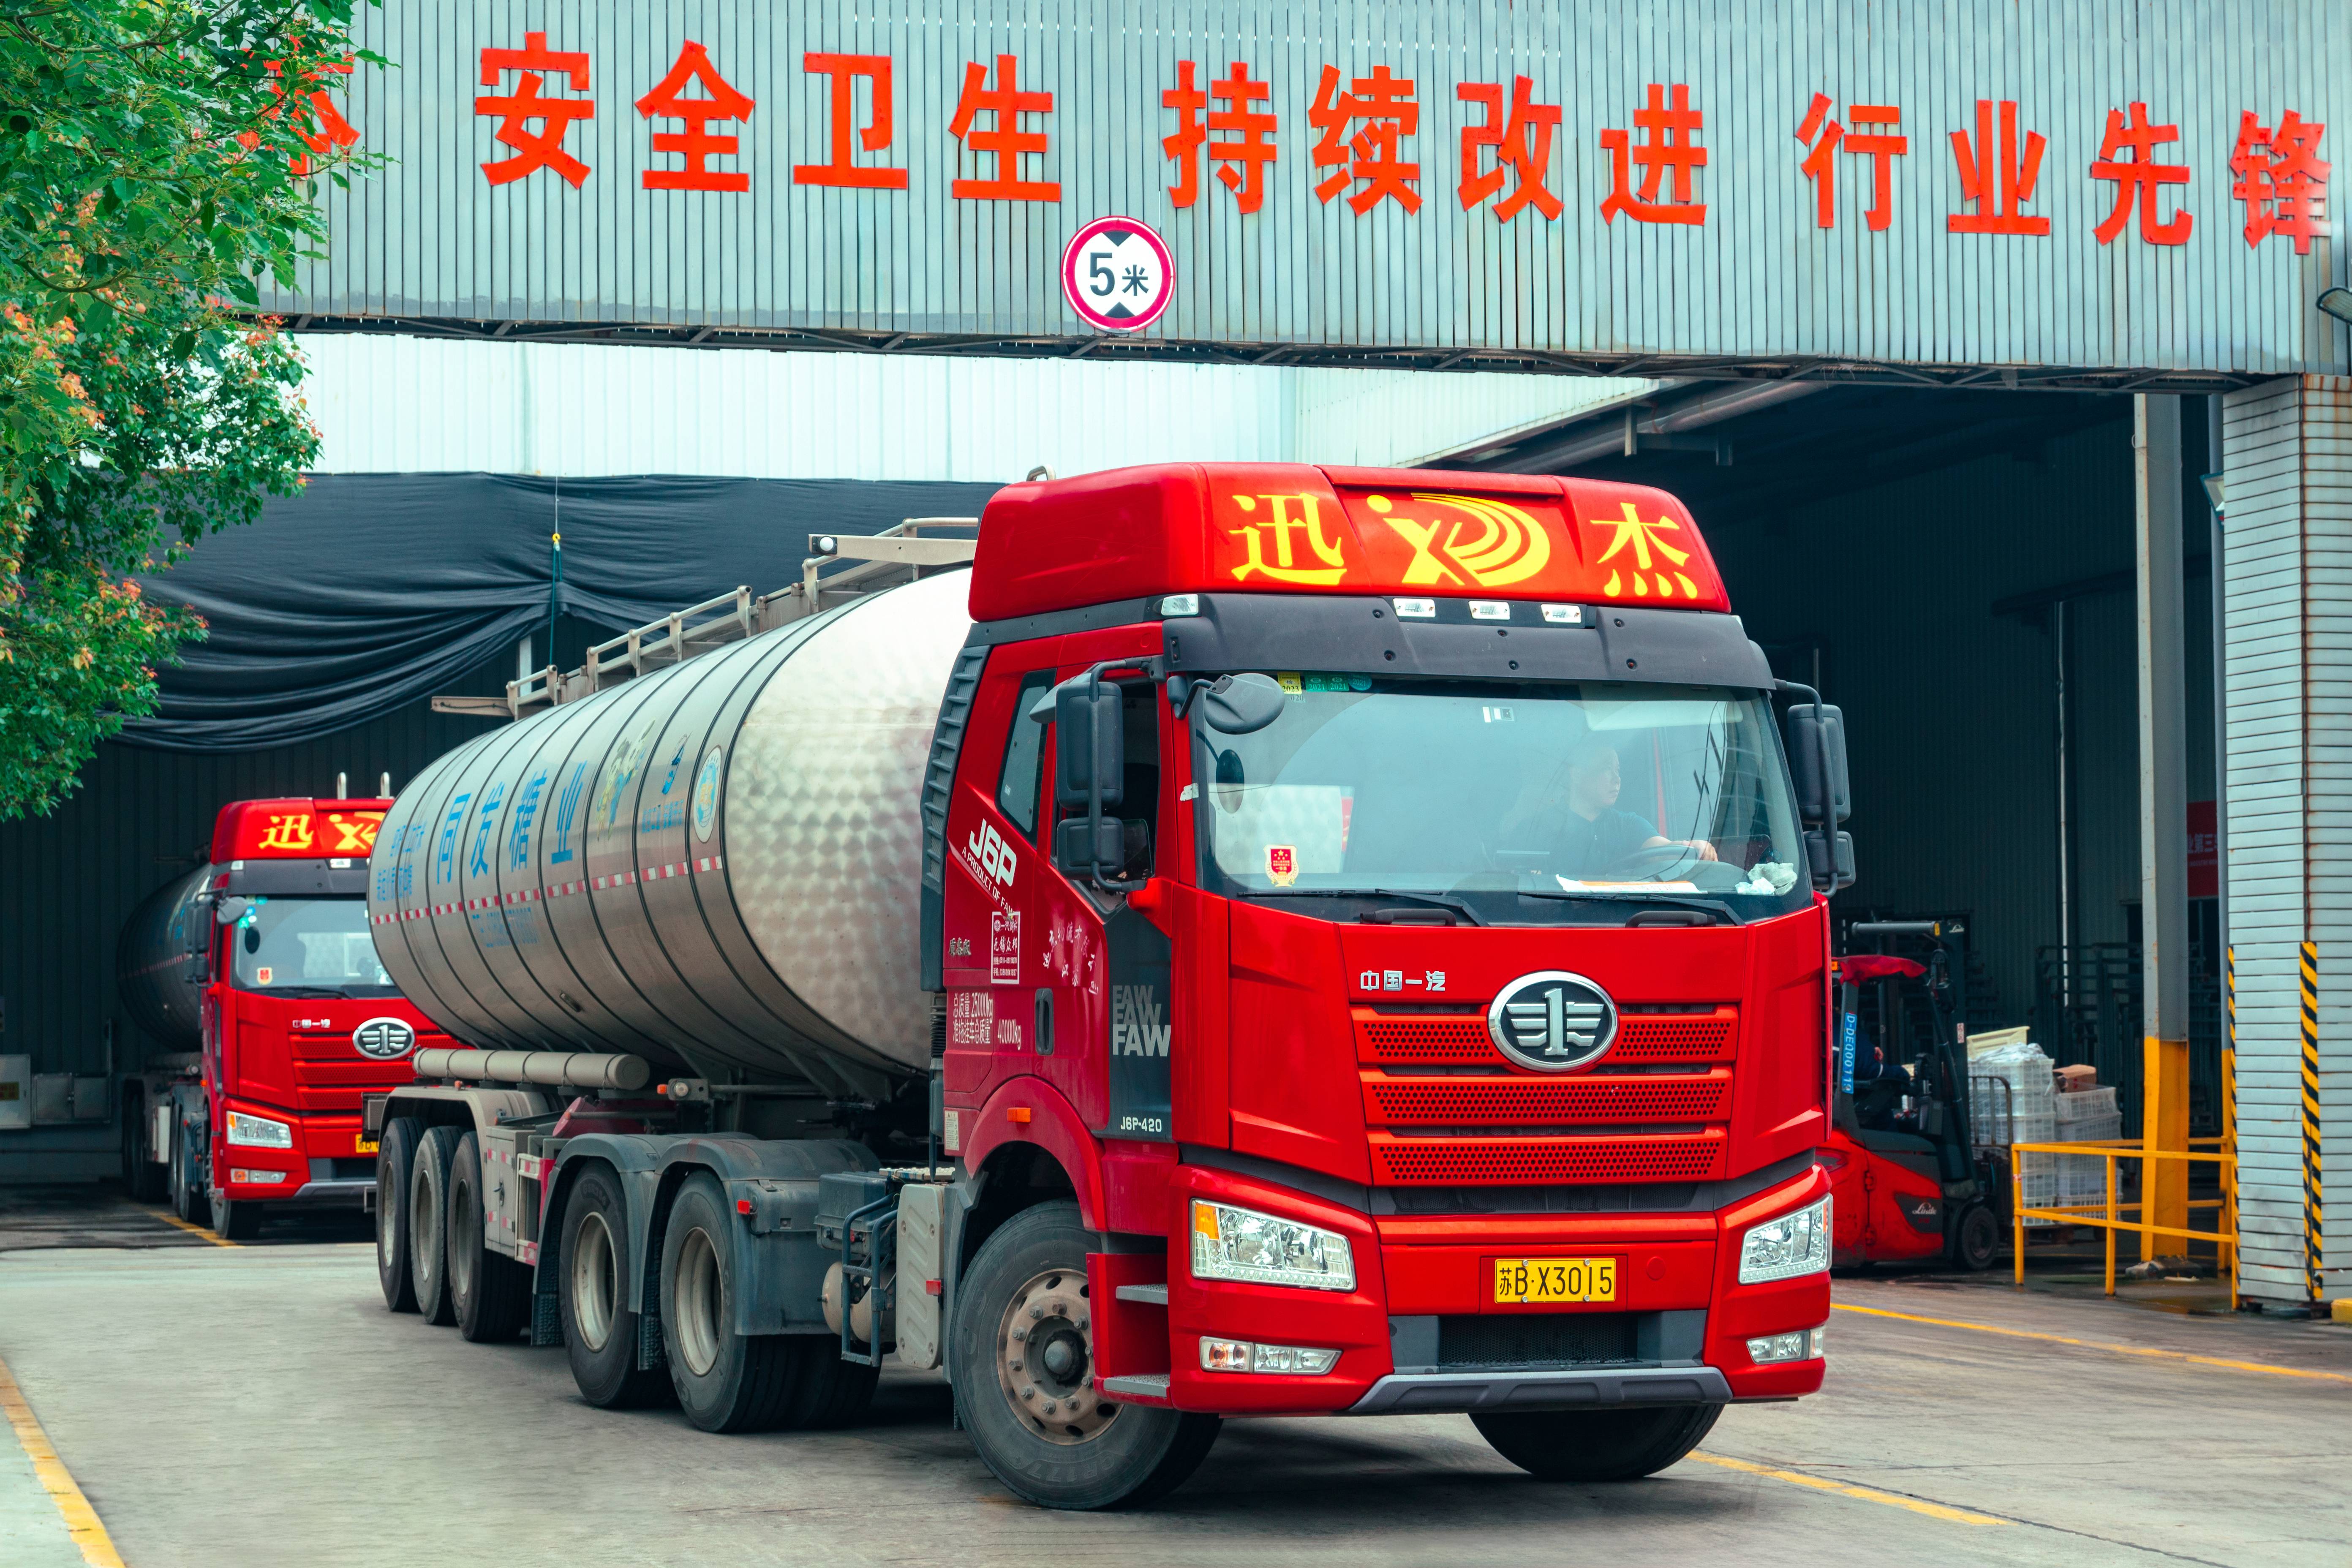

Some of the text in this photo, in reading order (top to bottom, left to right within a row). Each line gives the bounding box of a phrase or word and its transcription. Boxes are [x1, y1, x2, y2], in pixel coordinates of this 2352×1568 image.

[475, 31, 1061, 202] 安全卫生
[1162, 60, 1707, 226] 持续改进
[1796, 92, 2332, 255] 行业先锋
[1090, 252, 1149, 296] 5米
[1230, 493, 1699, 598] 迅 杰
[259, 814, 314, 850] 迅
[969, 818, 1017, 887] J6P
[962, 846, 966, 858] A
[967, 852, 992, 891] PRODUCT
[992, 886, 1000, 901] OF
[1360, 970, 1446, 992] 中国一汽
[953, 992, 993, 1024] 总质量 25000kg
[997, 1018, 1021, 1051] 40000kg
[1113, 1024, 1171, 1057] FAW
[1120, 1116, 1162, 1132] J6P-420
